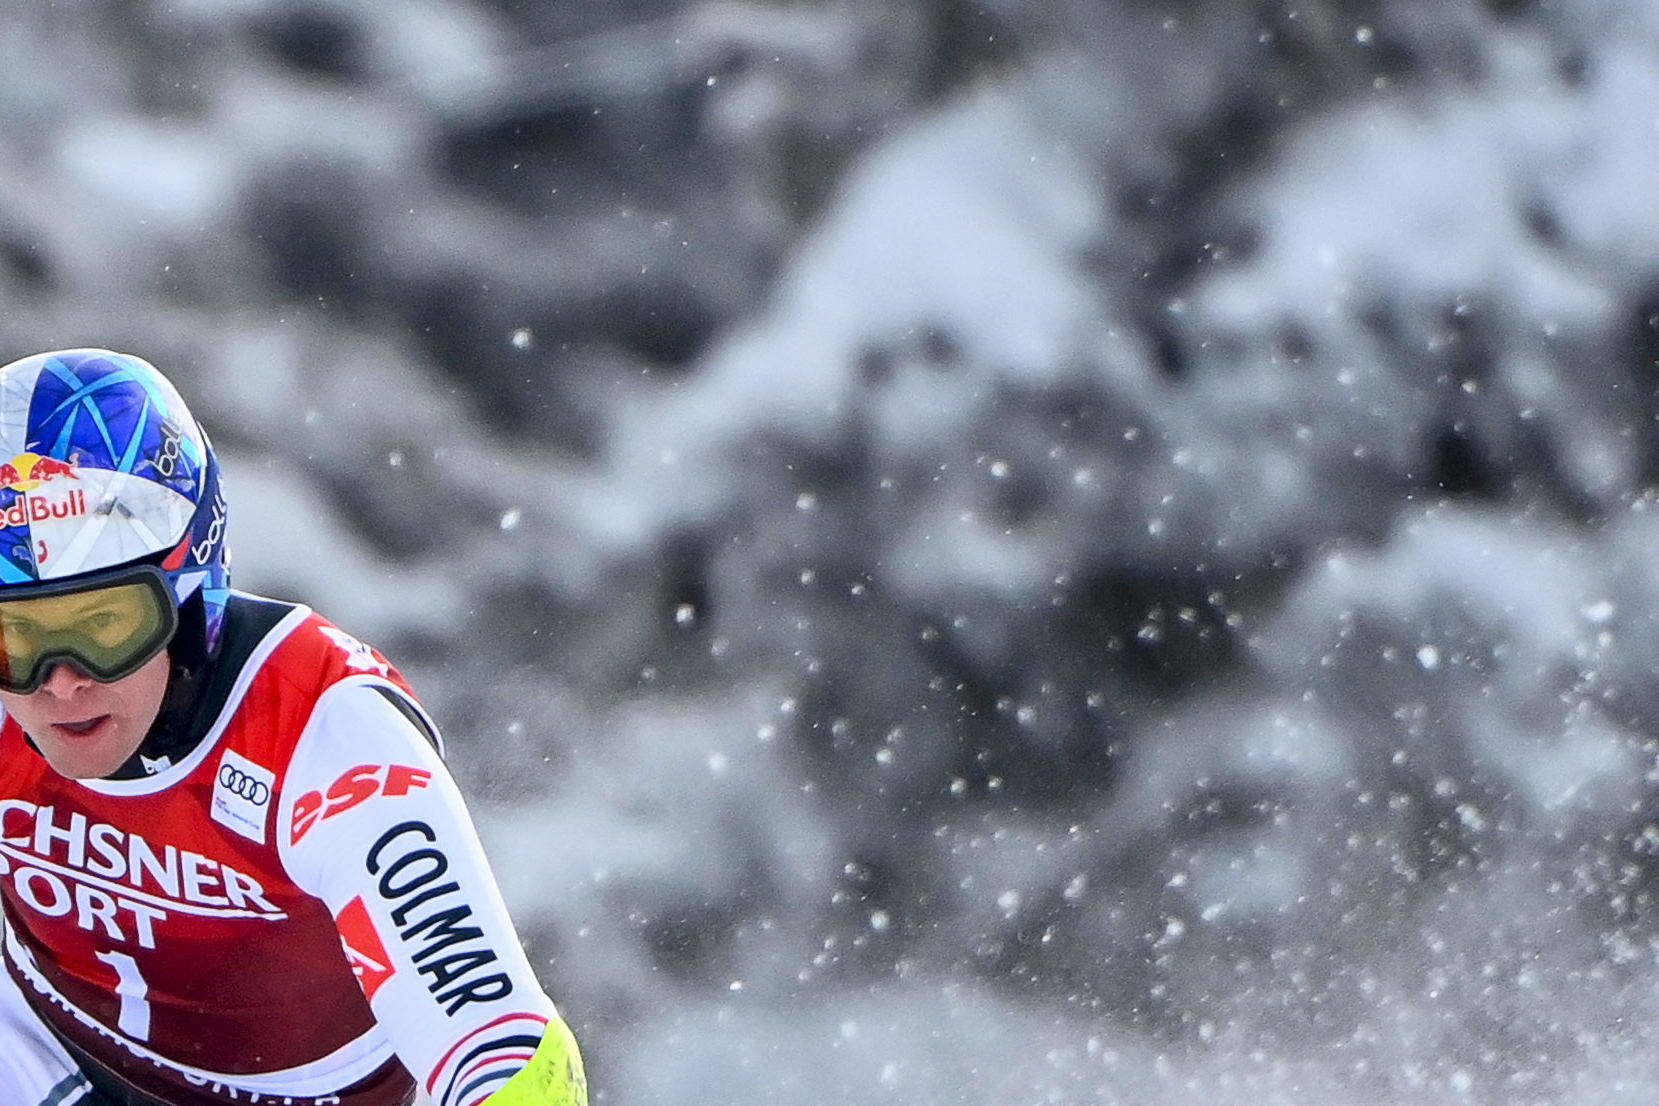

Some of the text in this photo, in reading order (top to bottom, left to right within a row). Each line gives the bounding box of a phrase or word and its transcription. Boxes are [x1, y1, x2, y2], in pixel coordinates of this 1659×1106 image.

[29, 488, 86, 522] Bull
[366, 820, 513, 1018] COLMAR
[93, 949, 151, 1042] 1
